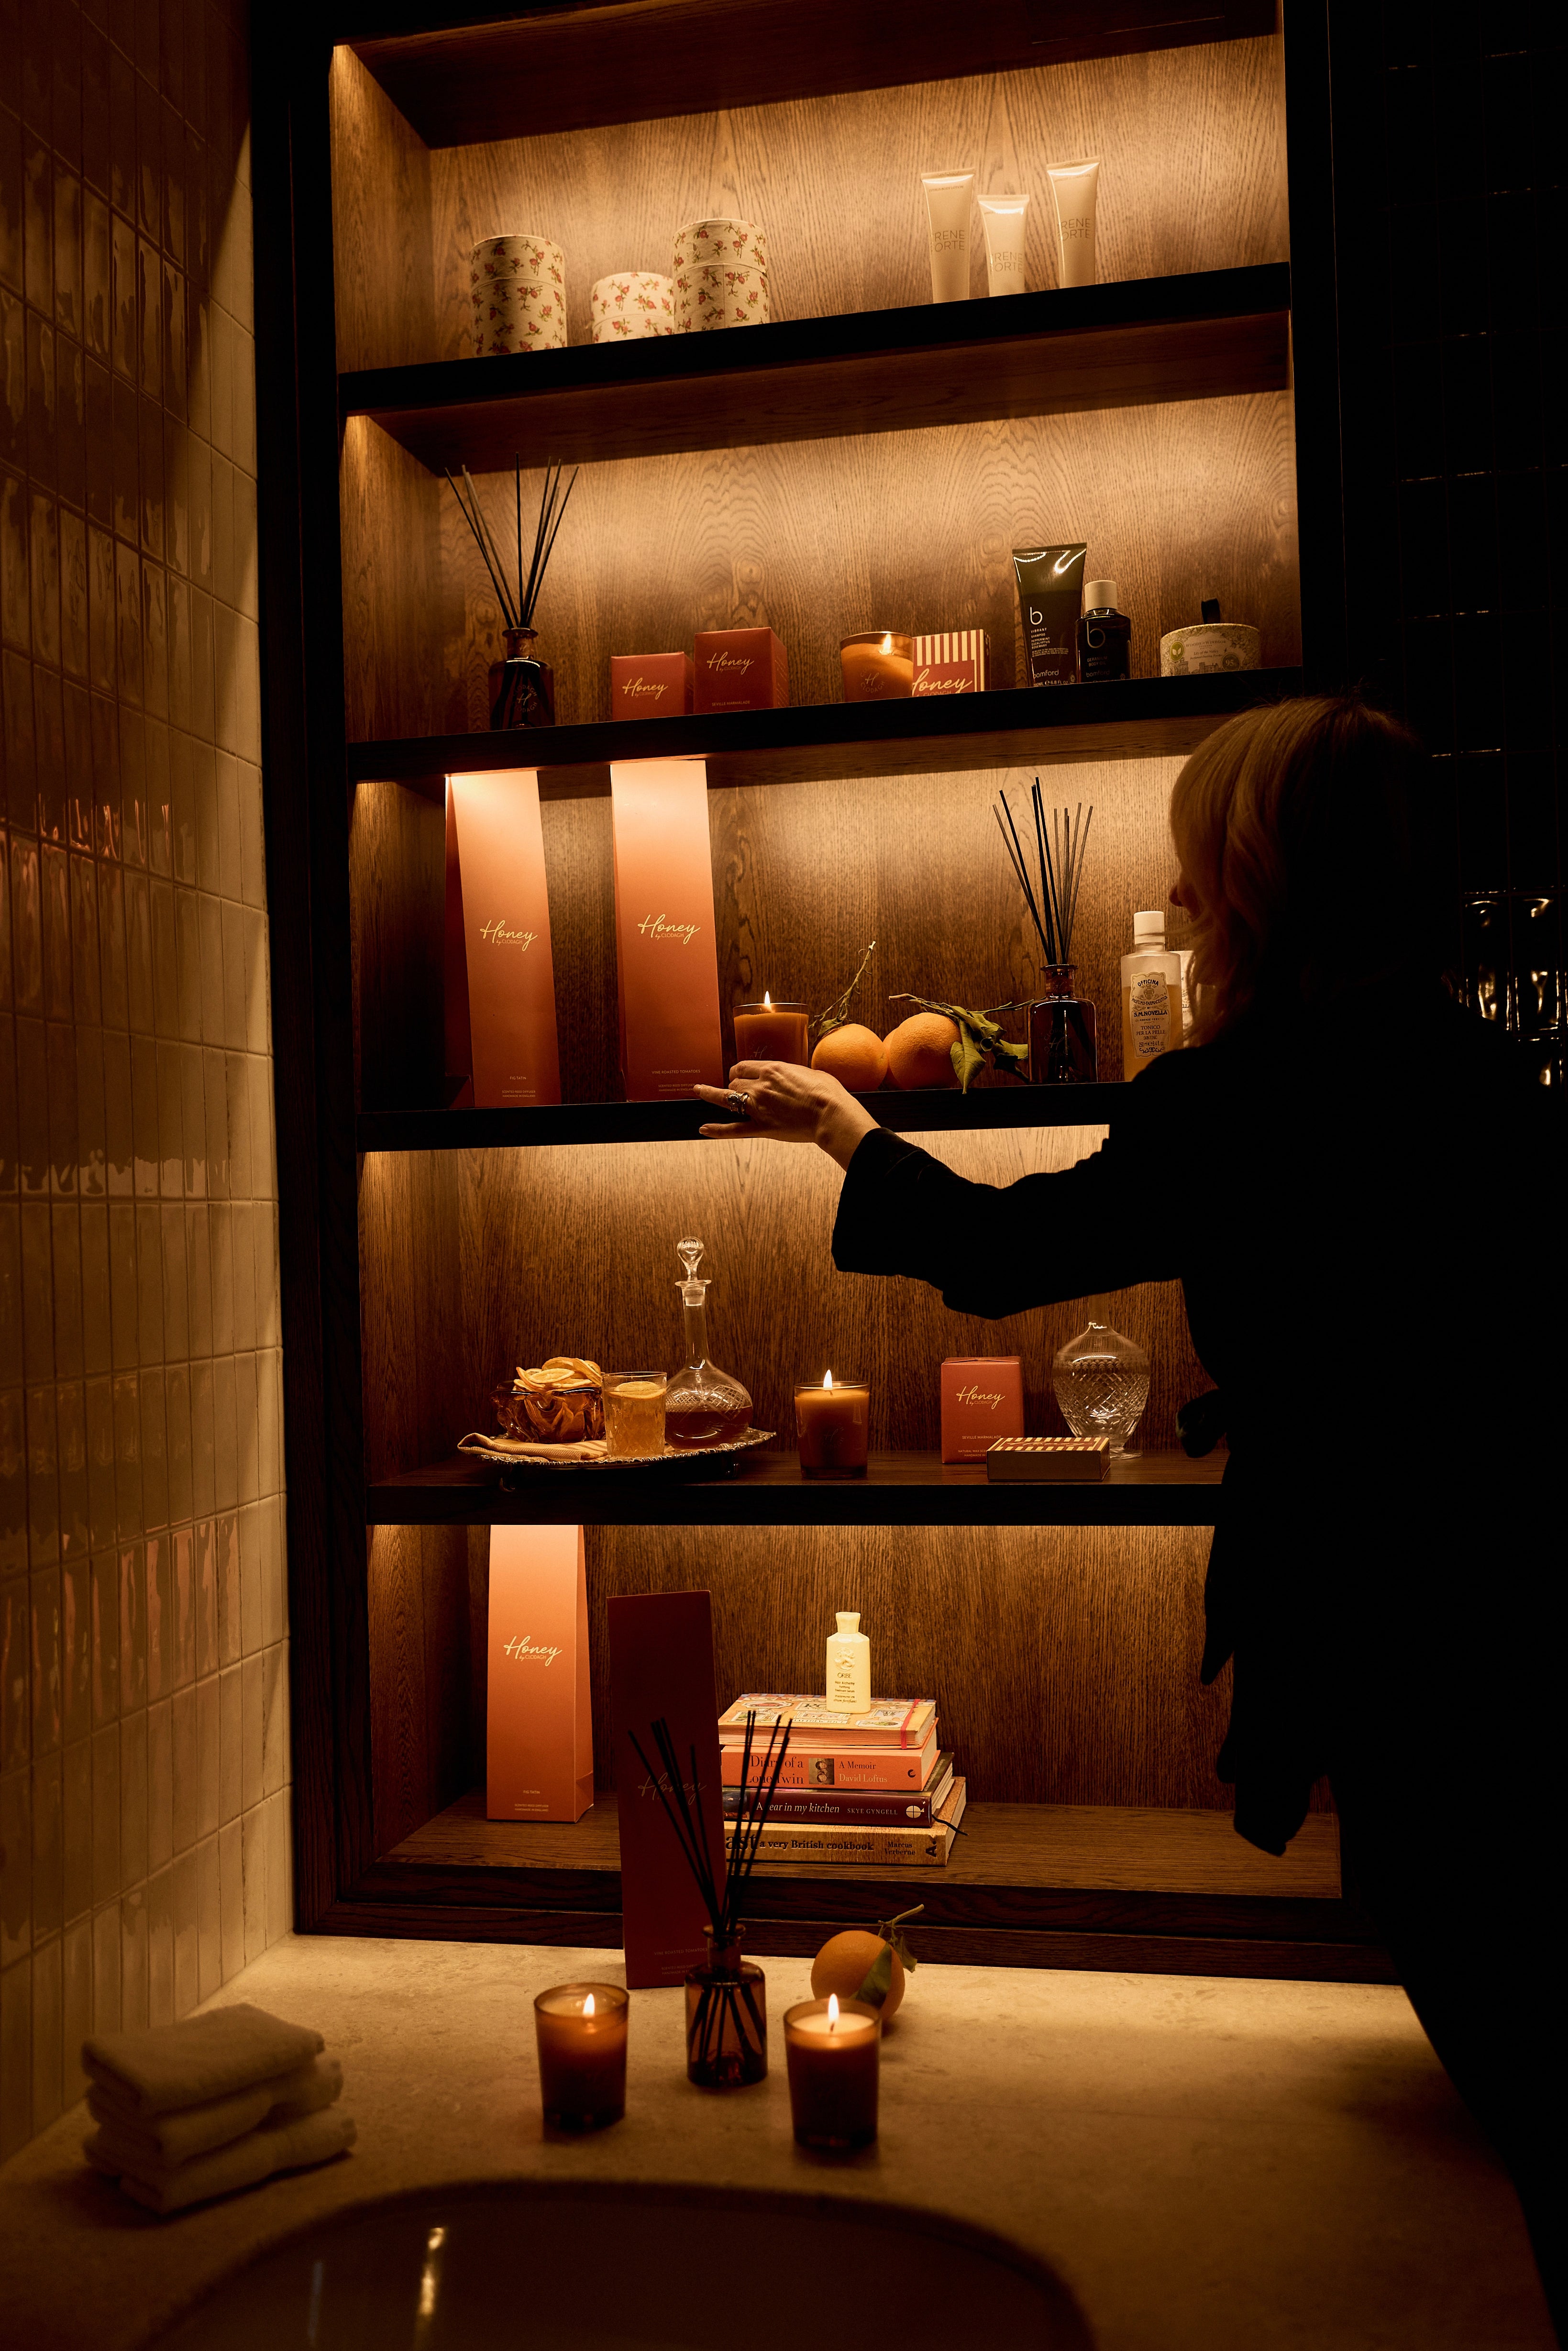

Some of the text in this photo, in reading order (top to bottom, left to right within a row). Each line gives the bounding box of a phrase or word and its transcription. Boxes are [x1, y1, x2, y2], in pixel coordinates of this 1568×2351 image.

[1058, 218, 1091, 230] RENE
[931, 230, 964, 242] RENE
[931, 241, 964, 252] ORTE
[992, 252, 1023, 262] RENE
[707, 651, 755, 675] Honey
[622, 677, 669, 700] Honey
[480, 919, 538, 951] Honey
[638, 914, 701, 945] Honey
[1137, 979, 1159, 987] OFFICINA
[956, 1385, 1005, 1410] Honey
[503, 1635, 563, 1667] Honey
[785, 1756, 796, 1768] of
[797, 1760, 804, 1768] a
[839, 1760, 876, 1769] A Memoir
[839, 1773, 888, 1783] David Loftus
[756, 1802, 763, 1810] A
[766, 1803, 783, 1811] ear
[784, 1802, 792, 1811] in
[794, 1804, 807, 1815] my
[809, 1802, 840, 1813] kitchen
[768, 1841, 789, 1850] very
[792, 1840, 825, 1850] British
[827, 1842, 874, 1851] cookbook
